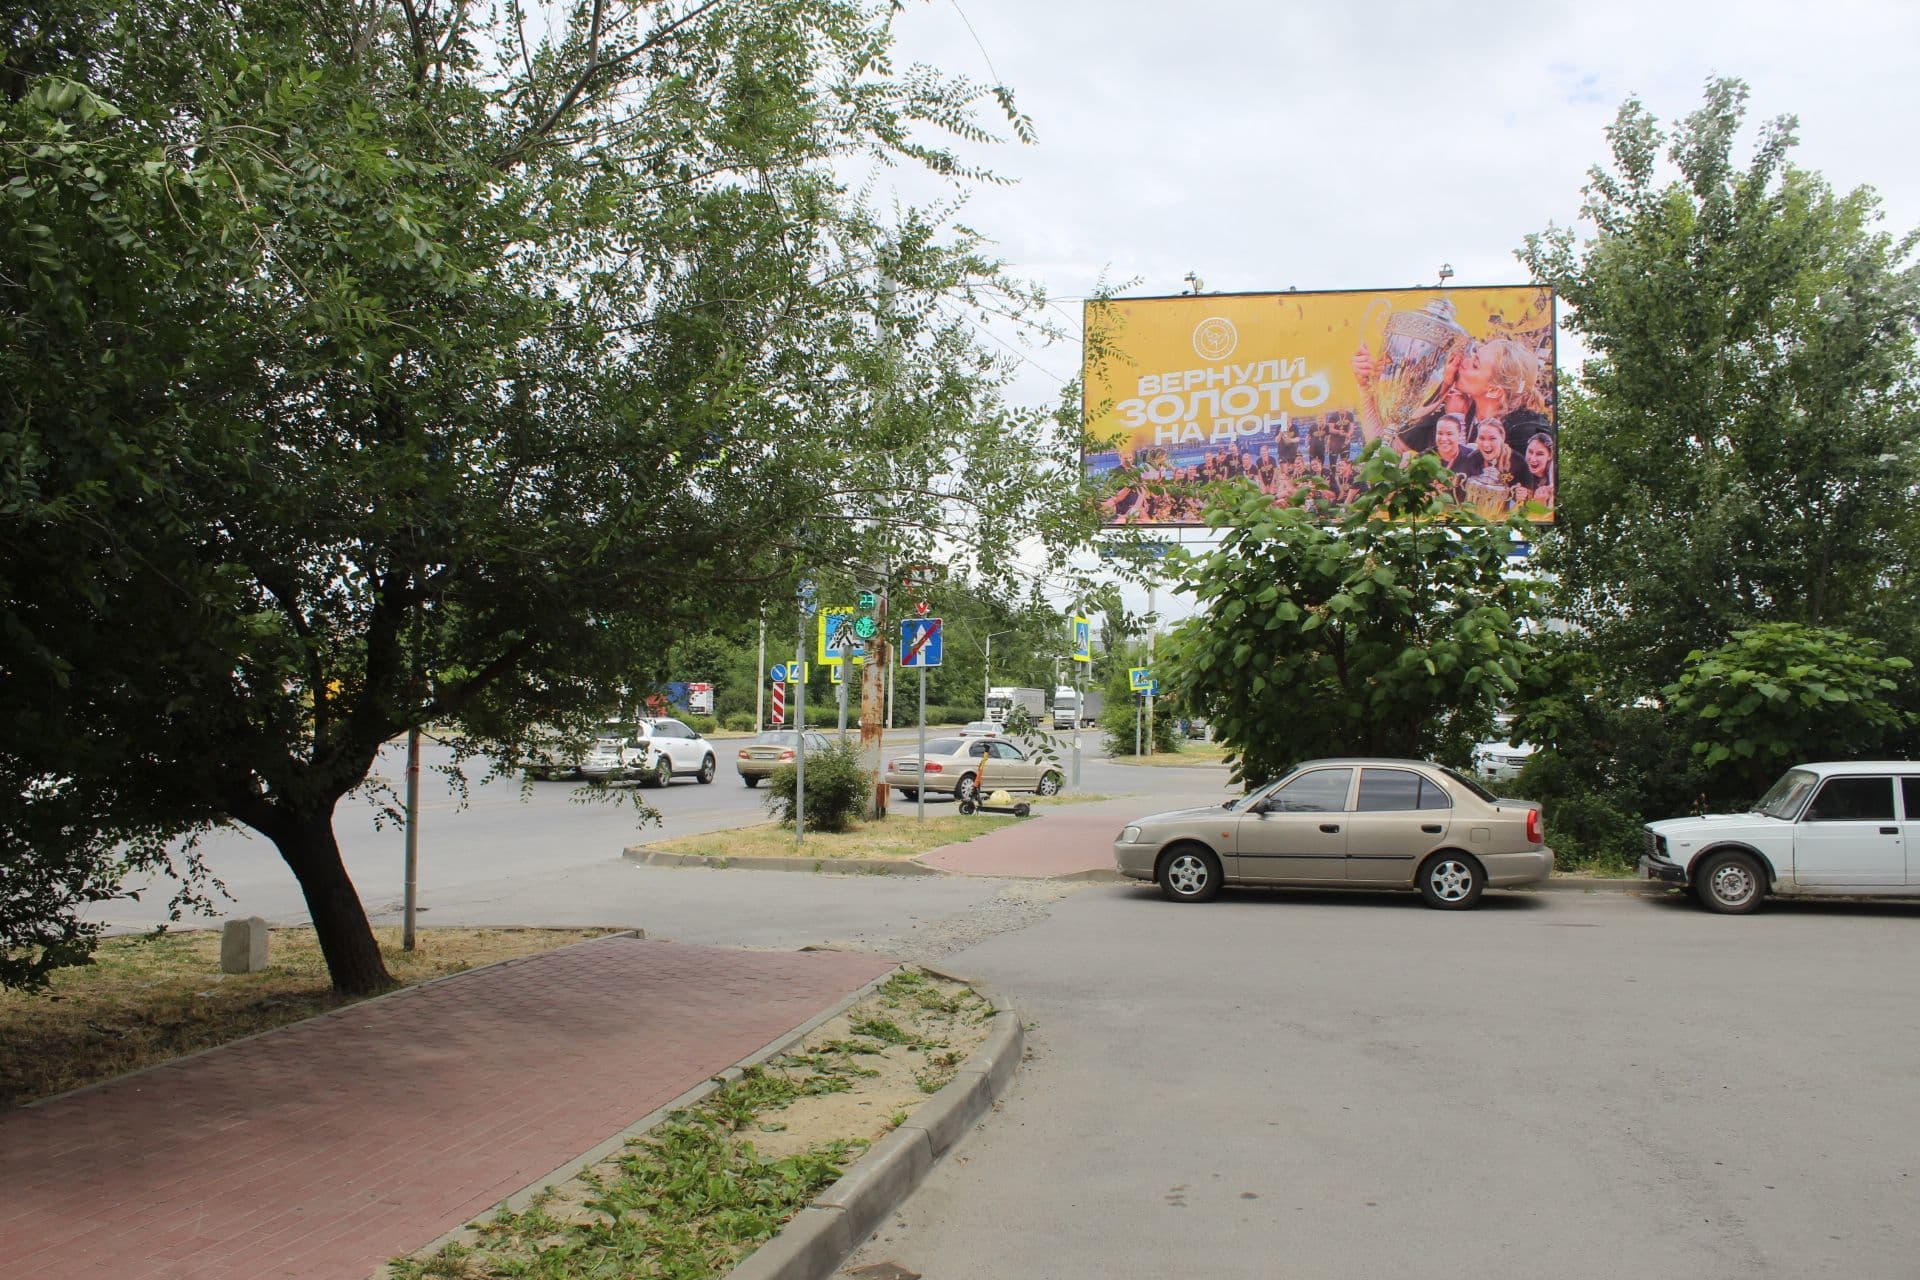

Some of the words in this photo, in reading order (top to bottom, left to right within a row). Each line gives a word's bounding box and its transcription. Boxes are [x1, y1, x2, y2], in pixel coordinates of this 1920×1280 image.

[1138, 357, 1305, 396] ВЕРНУЛИ
[1116, 372, 1330, 428] ЗОЛОТО
[1155, 422, 1204, 446] НА
[1210, 412, 1288, 445] ДОН
